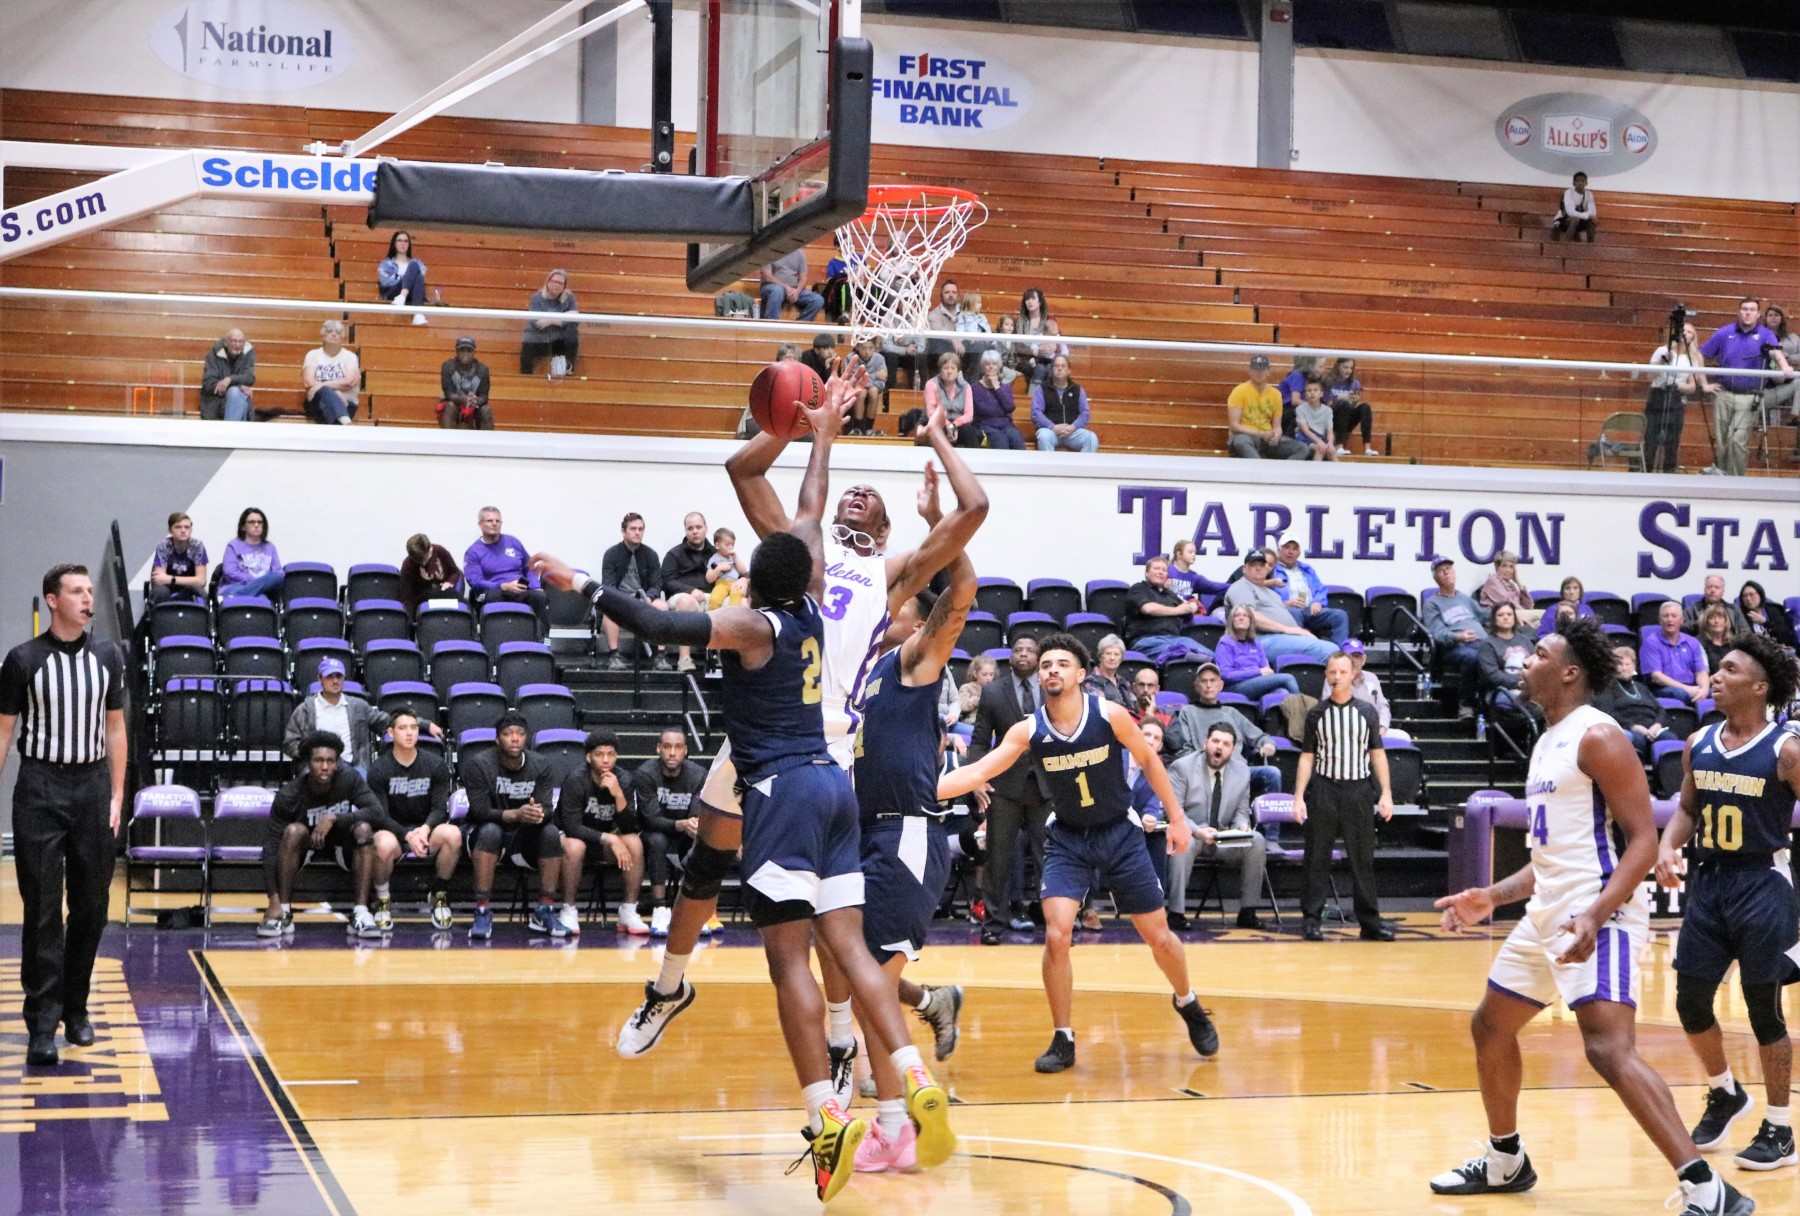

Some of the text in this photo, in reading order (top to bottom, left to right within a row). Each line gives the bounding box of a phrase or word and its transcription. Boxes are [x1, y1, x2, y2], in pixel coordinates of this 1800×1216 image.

[202, 20, 333, 58] National
[200, 56, 333, 73] FARM LIFE
[899, 52, 986, 80] FIRST
[872, 78, 1018, 107] FINANCIAL
[900, 104, 983, 128] BANK
[1546, 126, 1608, 150] ALLSUP'S
[1117, 484, 1800, 580] TARLETON STA
[824, 562, 873, 587] leton
[1043, 744, 1110, 772] CHAMPION
[1075, 771, 1095, 808] 1
[1692, 769, 1767, 797] CHAMPION
[1701, 803, 1743, 851] 10
